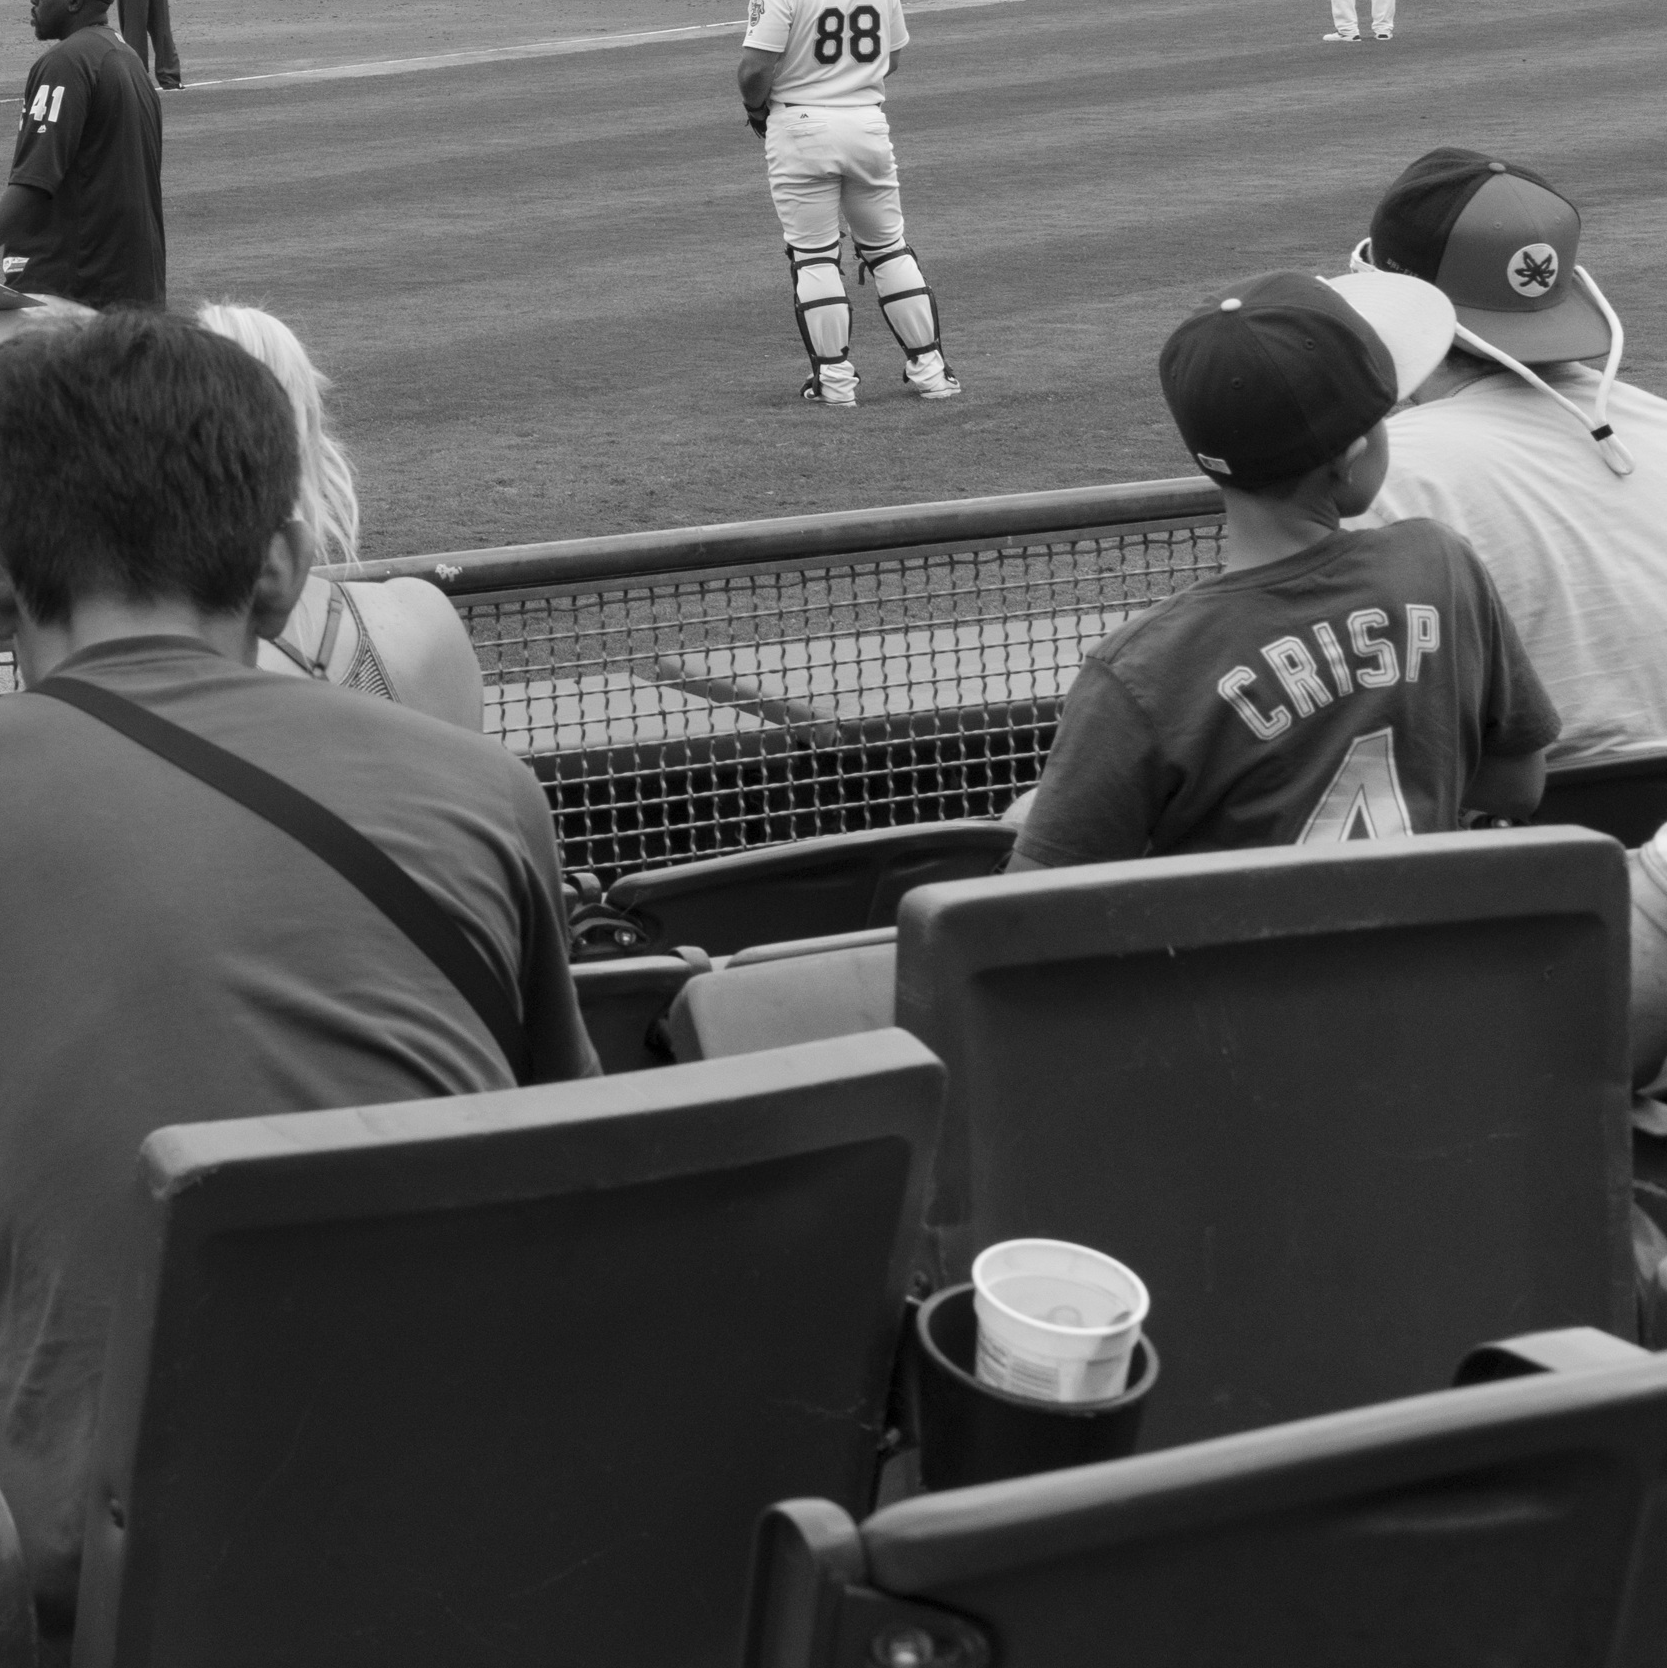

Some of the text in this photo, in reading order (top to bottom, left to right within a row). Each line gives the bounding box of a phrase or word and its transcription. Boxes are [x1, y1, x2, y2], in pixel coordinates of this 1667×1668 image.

[814, 4, 881, 65] 88
[30, 84, 65, 123] 41
[1218, 603, 1441, 741] CRISP
